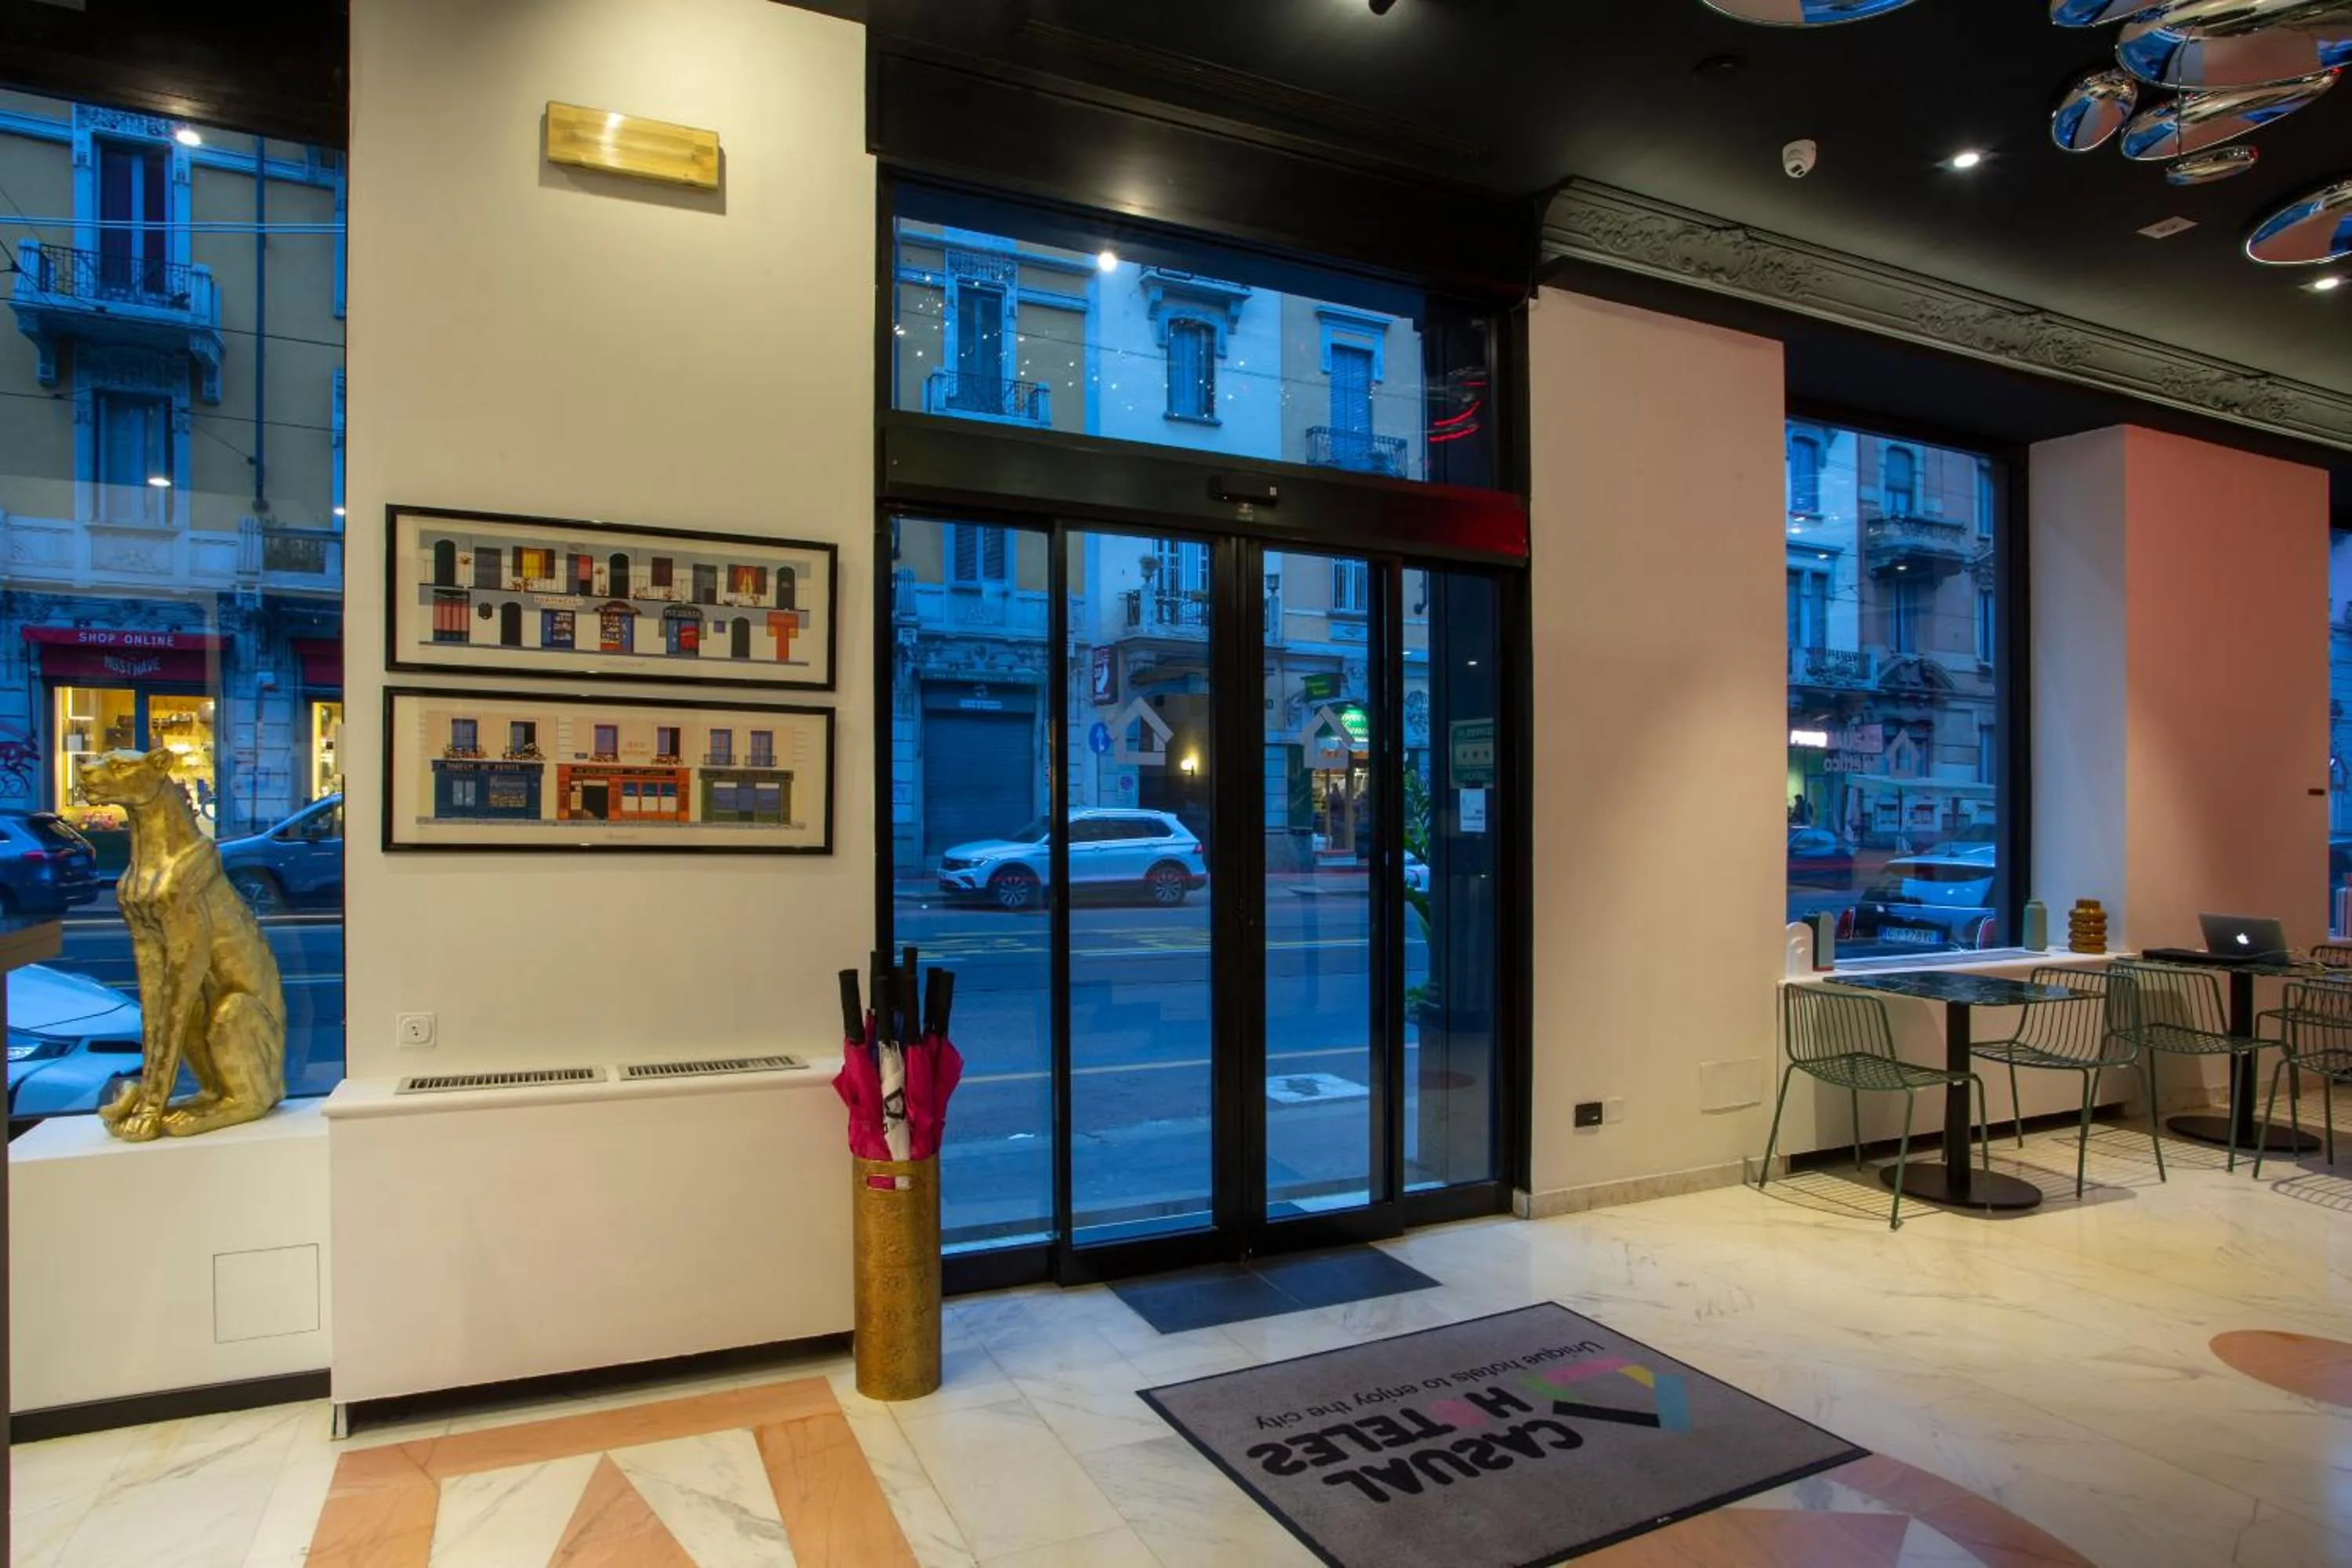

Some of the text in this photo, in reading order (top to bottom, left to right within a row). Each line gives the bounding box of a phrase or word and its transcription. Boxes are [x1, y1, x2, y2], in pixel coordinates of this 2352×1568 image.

[78, 632, 174, 648] SHOP ONLINE
[1256, 1341, 1605, 1430] Unique hotels to enjoy the city
[1323, 1420, 1583, 1502] CASUAL
